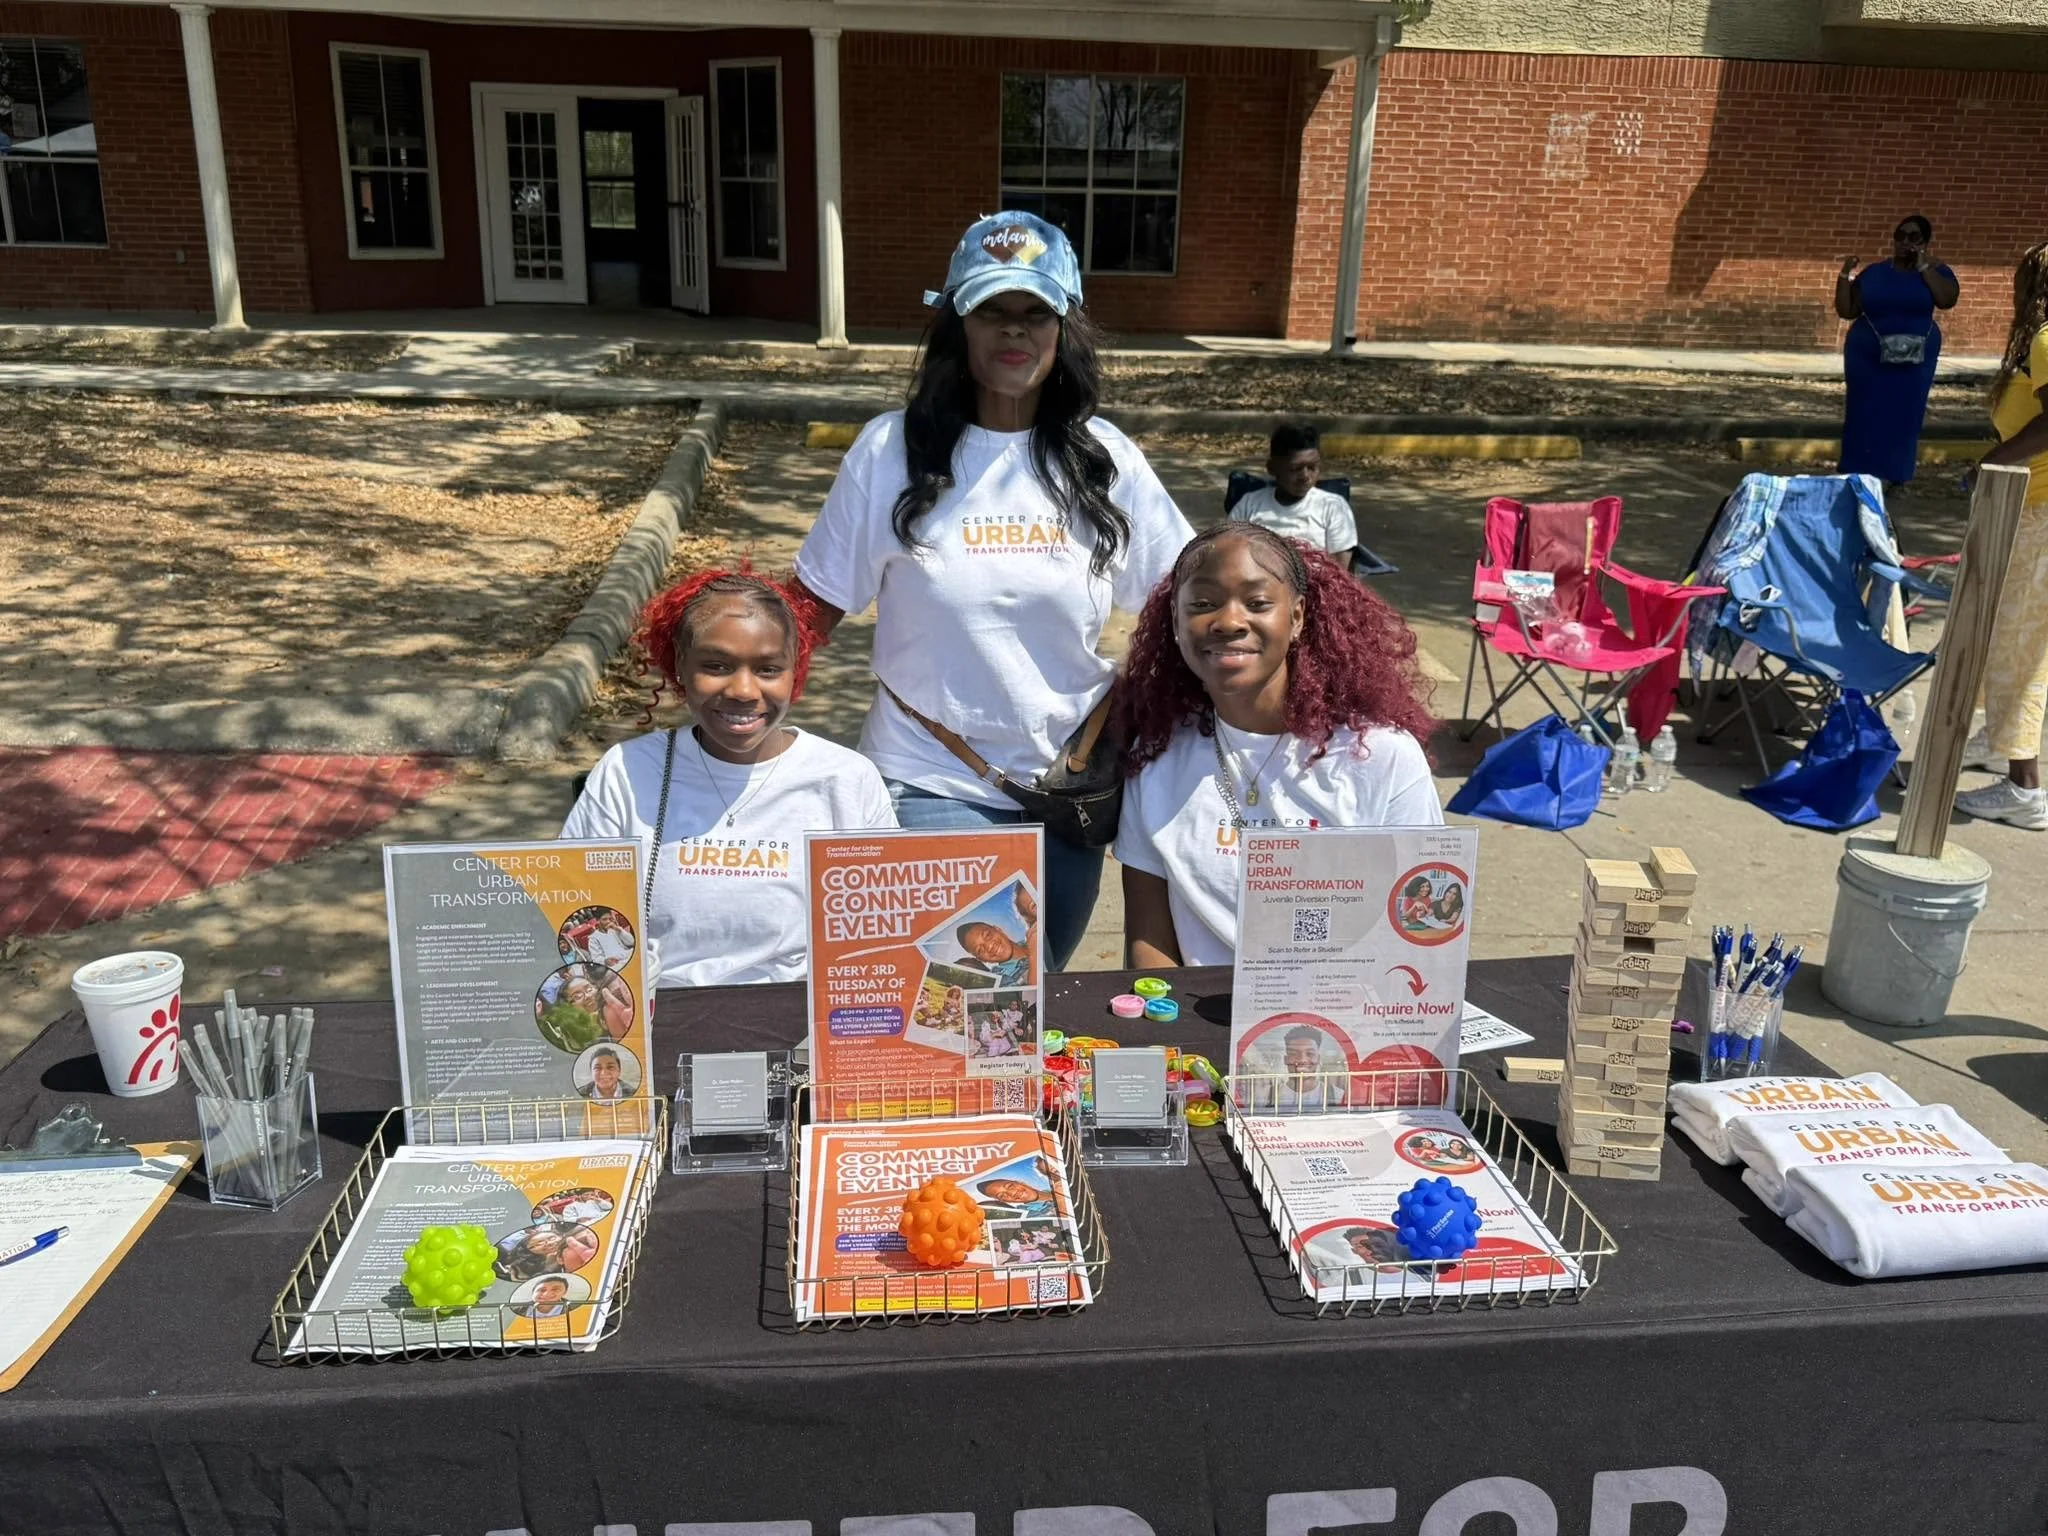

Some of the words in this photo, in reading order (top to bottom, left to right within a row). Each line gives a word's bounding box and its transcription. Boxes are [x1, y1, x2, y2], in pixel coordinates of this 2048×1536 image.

[962, 515, 1026, 525] CENTER
[962, 525, 1067, 545] URBAN
[966, 546, 1069, 555] TRANSFORMATION
[1218, 818, 1277, 828] CENTER
[680, 837, 746, 847] CENTER
[758, 839, 790, 849] FOR
[1248, 840, 1300, 850] CENTER
[453, 857, 521, 872] CENTER
[527, 855, 561, 869] FOR
[587, 856, 631, 866] URBAN
[678, 846, 789, 868] URBAN
[1248, 853, 1274, 864] FOR
[678, 867, 788, 878] TRANSFORMATION
[823, 858, 993, 892] COMMUNITY
[1247, 867, 1292, 878] URBAN
[478, 874, 538, 888] URBAN
[1247, 880, 1364, 891] TRANSFORMATION
[429, 889, 592, 908] TRANSFORMATION
[825, 885, 956, 915] CONNECT
[1263, 894, 1294, 905] Juvenile
[1295, 894, 1330, 904] Diversion
[1331, 894, 1364, 905] Program
[1634, 888, 1663, 902] Jenga
[827, 912, 912, 938] EVENT
[1623, 921, 1650, 935] Jenga
[1622, 956, 1650, 970] Jenga
[827, 965, 869, 977] EVERY
[872, 964, 896, 976] 3RD
[827, 978, 886, 991] TUESDAY
[888, 978, 906, 989] OF
[827, 994, 852, 1004] THE
[854, 992, 902, 1004] MONTH
[1612, 986, 1639, 999] Jenga
[1363, 1003, 1414, 1018] Inquire
[1417, 1002, 1456, 1014] Now!
[1612, 1017, 1639, 1031] Jenga
[1608, 1052, 1634, 1066] Jenga
[1537, 1070, 1560, 1080] Jenga
[1610, 1082, 1638, 1097] Jenga
[1727, 1084, 1884, 1105] URBAN
[1744, 1101, 1892, 1112] TRANSFORMATION
[1609, 1118, 1636, 1130] Jenga
[1788, 1120, 1880, 1132] CENTER
[1895, 1120, 1939, 1132] FOR
[1796, 1127, 1961, 1153] URBAN
[839, 1144, 1010, 1165] COMMUNITY
[1598, 1146, 1624, 1160] Jenga
[1814, 1146, 1972, 1164] TRANSFORMATION
[448, 1164, 516, 1173] CENTER
[520, 1160, 555, 1172] FOR
[840, 1160, 974, 1178] CONNECT
[468, 1173, 528, 1183] URBAN
[840, 1175, 928, 1193] EVENT
[1976, 1172, 2027, 1184] FOR
[414, 1178, 580, 1194] TRANSFORMATION
[1870, 1179, 2048, 1204] URBAN
[837, 1207, 881, 1215] EVERY
[836, 1214, 901, 1224] TUESDAY
